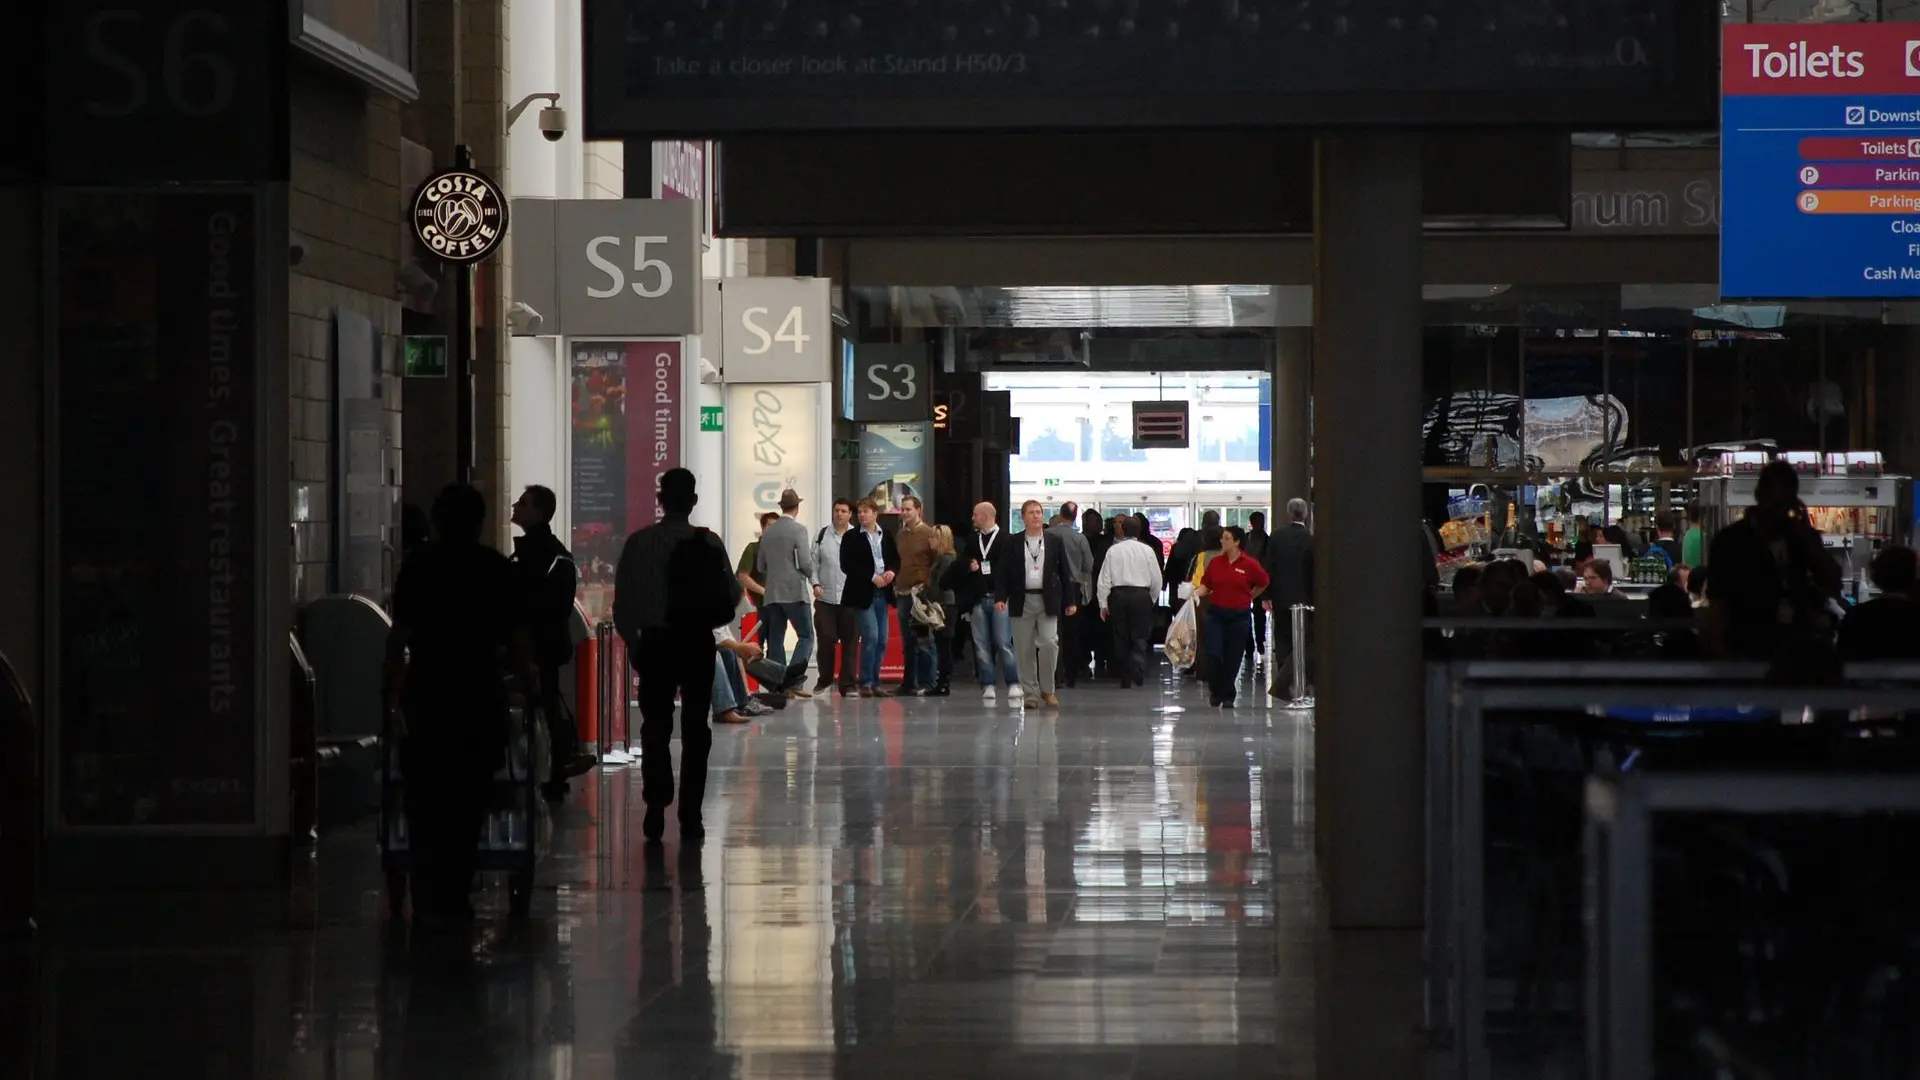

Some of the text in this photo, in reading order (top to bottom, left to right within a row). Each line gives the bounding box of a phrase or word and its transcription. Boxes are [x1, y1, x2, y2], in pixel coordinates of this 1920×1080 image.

[84, 8, 236, 117] S6
[654, 53, 1026, 75] Take a closer look at Stand H50/3
[1743, 40, 1865, 78] Toilets
[1861, 142, 1906, 155] Toilets
[426, 176, 488, 202] COSTA
[422, 224, 496, 256] COFFEE
[585, 236, 673, 298] S5
[1863, 266, 1897, 280] Cash
[741, 306, 810, 354] S4
[655, 352, 672, 404] Good
[867, 363, 916, 401] S3
[652, 408, 672, 467] times,
[752, 390, 786, 466] EXPO
[203, 210, 240, 714] Good times, Great restaurants
